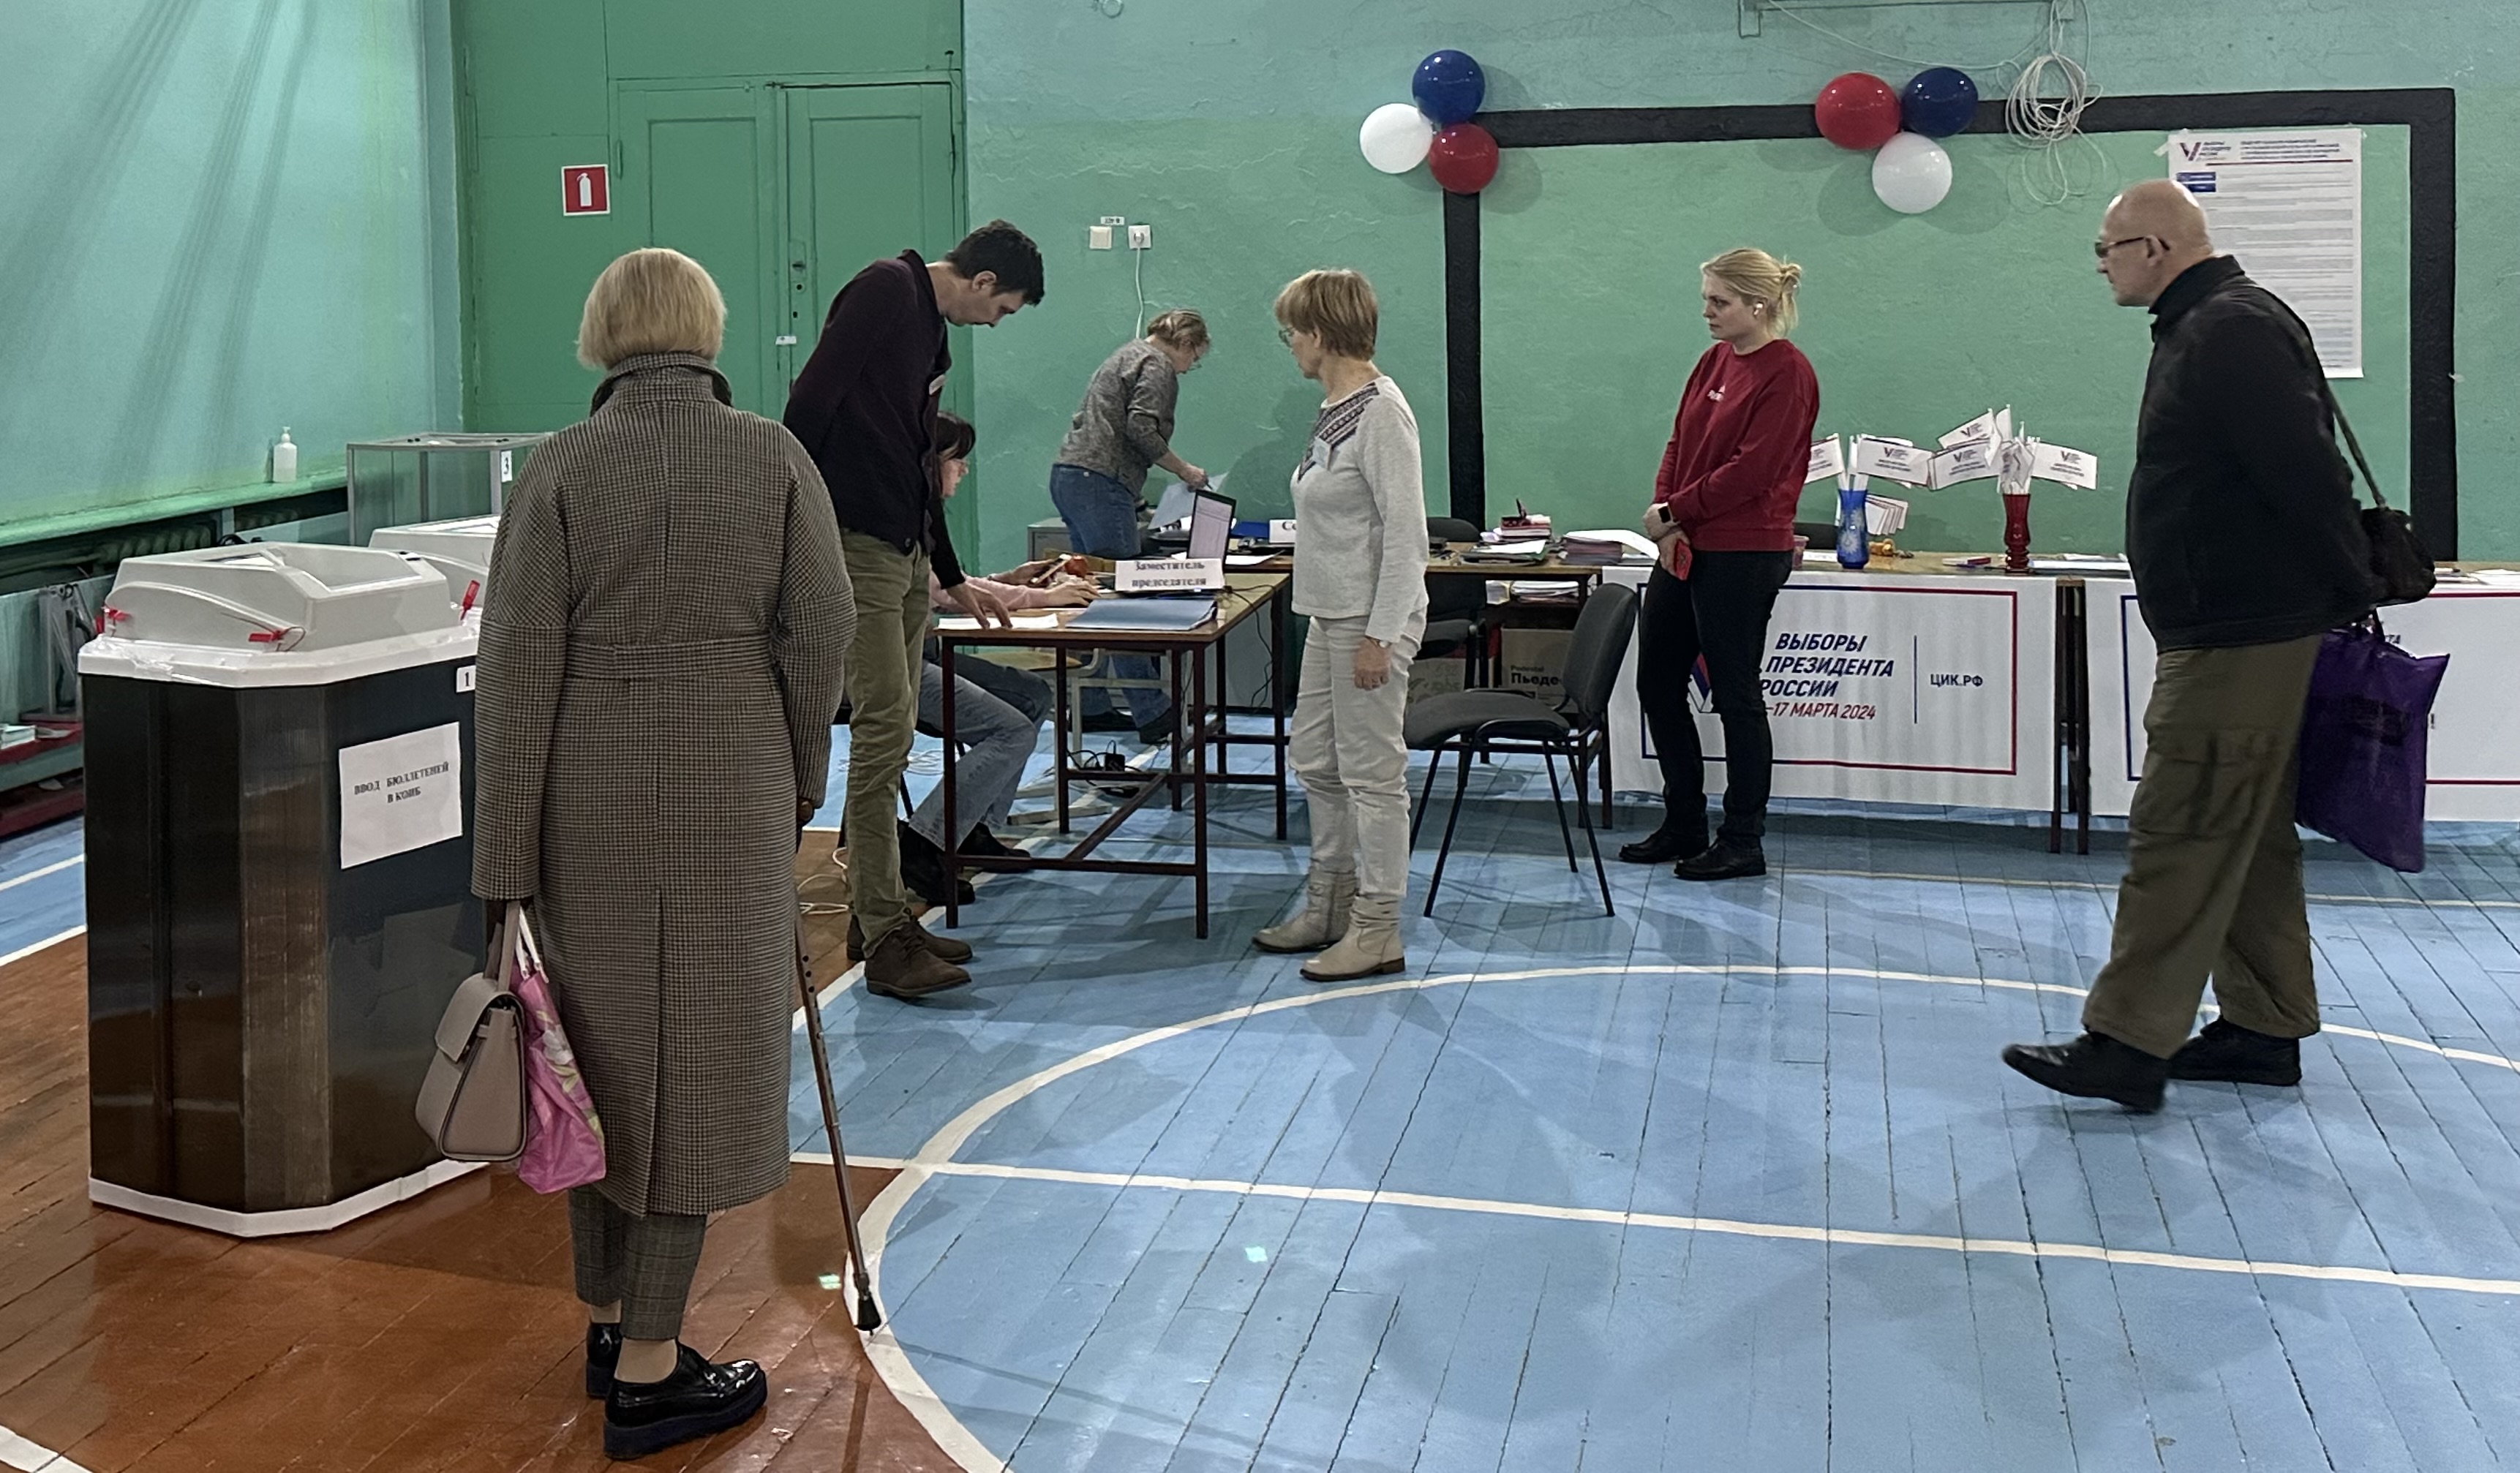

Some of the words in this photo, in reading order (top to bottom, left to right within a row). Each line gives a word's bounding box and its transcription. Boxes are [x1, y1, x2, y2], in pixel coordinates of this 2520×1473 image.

[502, 456, 510, 475] 3
[1135, 560, 1206, 571] Заместитель
[1775, 633, 1868, 652] ВЫБОРЫ
[1765, 655, 1895, 677] ПРЕЗИДЕНТА
[1511, 672, 1562, 687] Пьеде
[1761, 679, 1839, 698] РОССИИ
[1930, 674, 1984, 687] ЦИК.РФ
[1789, 702, 1840, 718] МАРТА
[1840, 704, 1877, 720] 2024
[354, 780, 380, 795] ВВОД
[386, 761, 449, 788] БЮЛЛЕТЕНЕЙ
[387, 794, 394, 803] В
